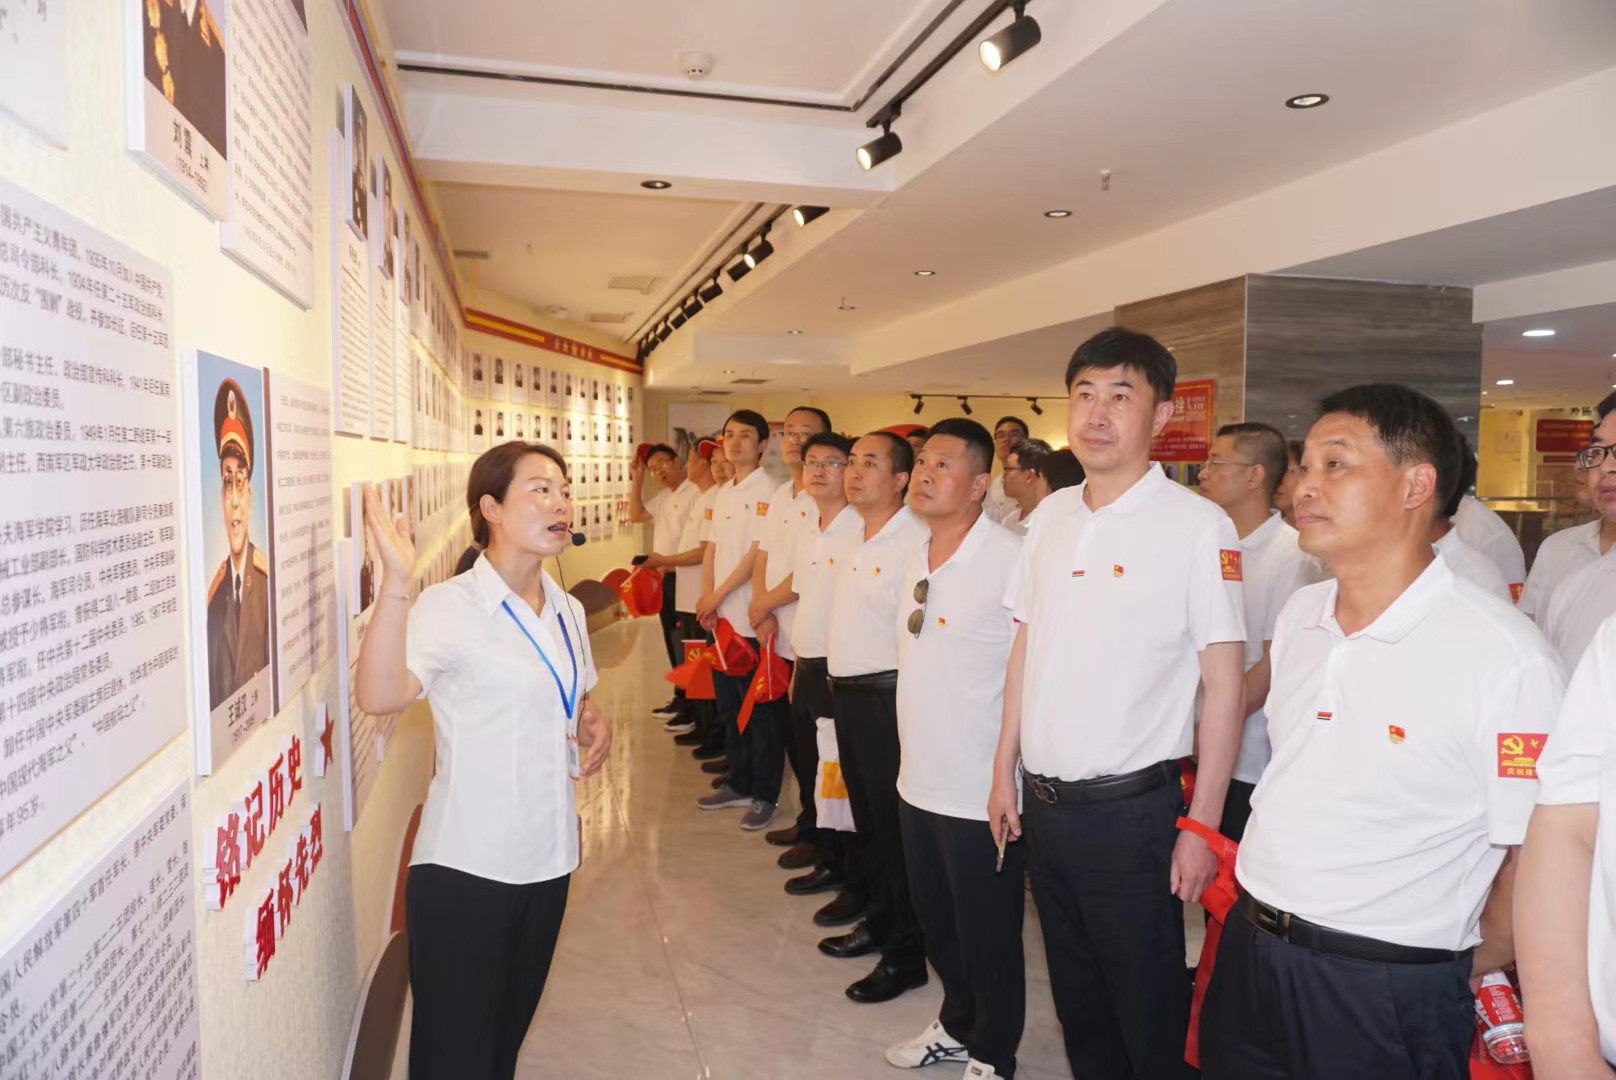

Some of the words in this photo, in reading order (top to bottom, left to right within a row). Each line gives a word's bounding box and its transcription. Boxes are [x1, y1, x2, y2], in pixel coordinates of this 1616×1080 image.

[216, 735, 302, 909] 铭记历史
[1507, 767, 1536, 776] 庆祝建
[256, 802, 323, 980] 缅怀先烈
